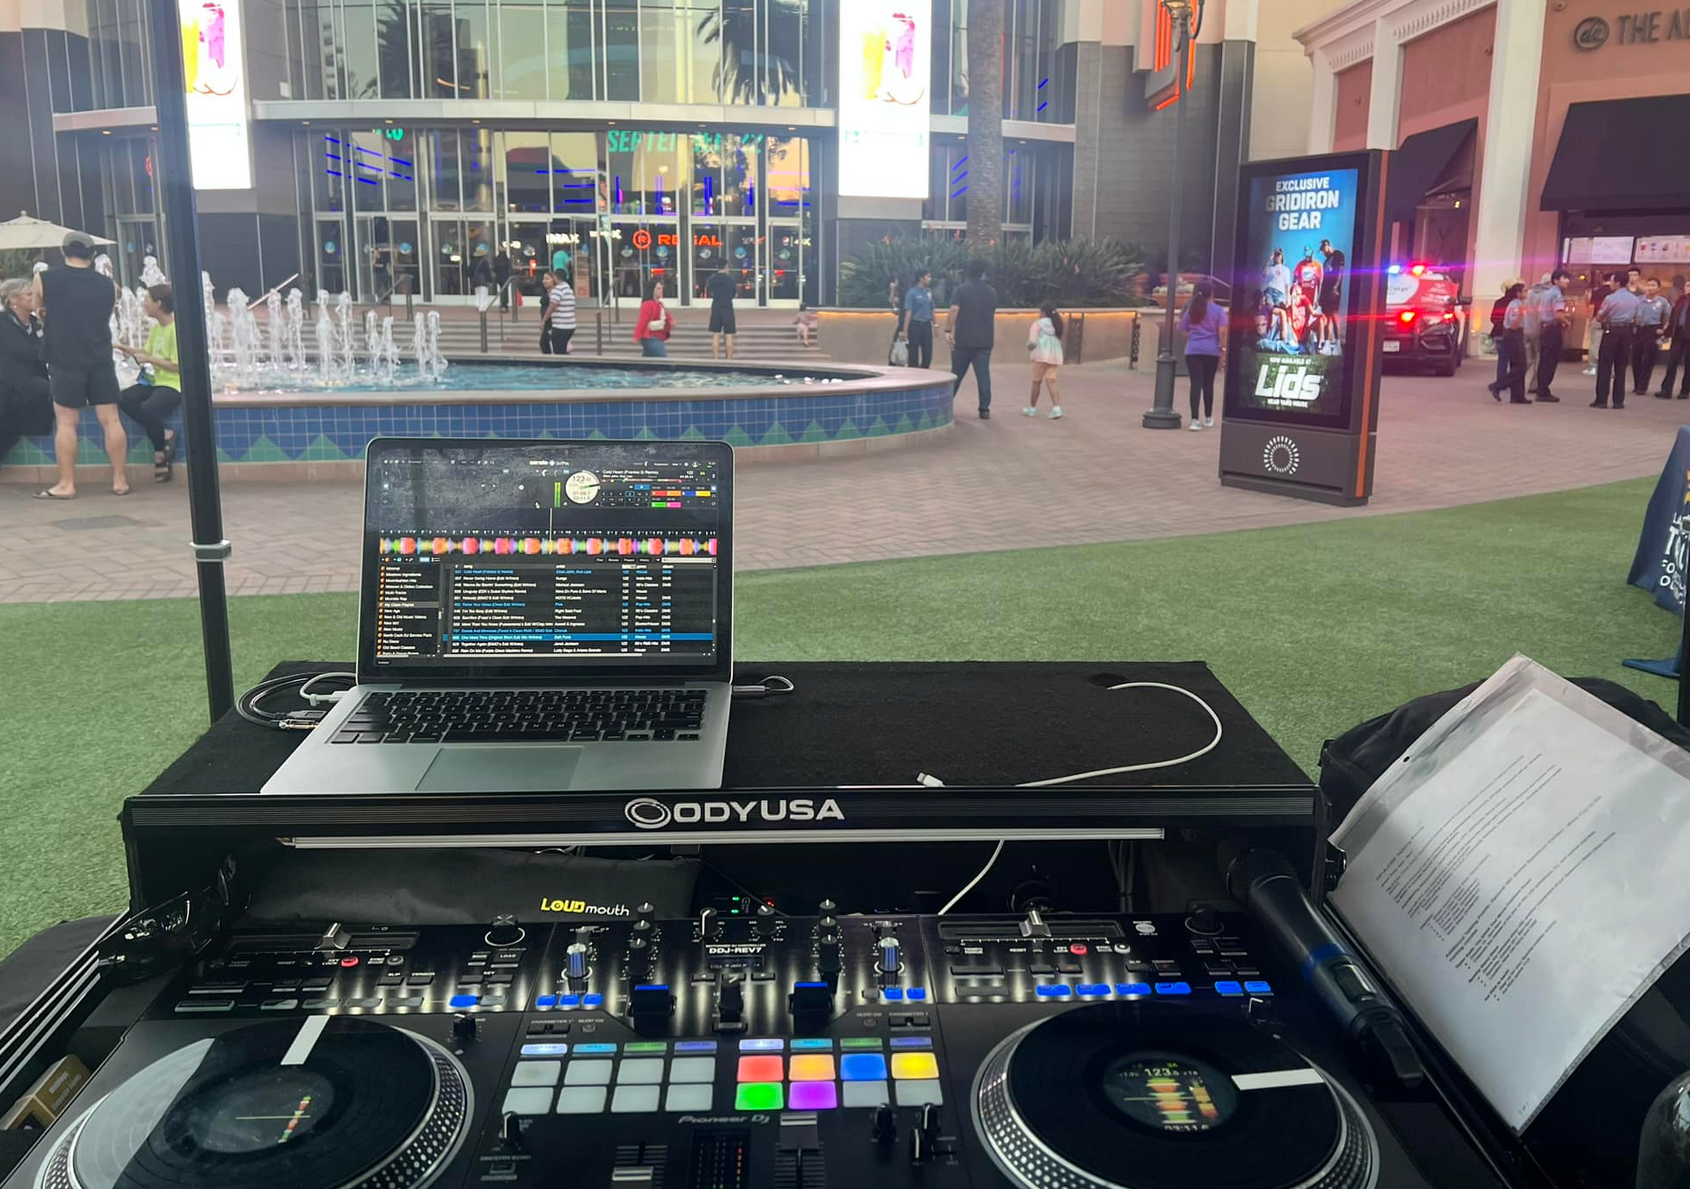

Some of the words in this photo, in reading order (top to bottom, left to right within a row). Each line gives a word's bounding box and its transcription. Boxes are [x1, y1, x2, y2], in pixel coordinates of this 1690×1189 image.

[1619, 11, 1662, 45] THE
[1276, 177, 1330, 192] EXCLUSIVE
[1266, 190, 1339, 212] GRIDIRON
[1279, 211, 1321, 230] GEAR
[546, 233, 580, 244] IMAX
[1255, 363, 1321, 400] Lids
[674, 798, 845, 823] ODYUSA
[678, 1115, 748, 1124] Pioneer
